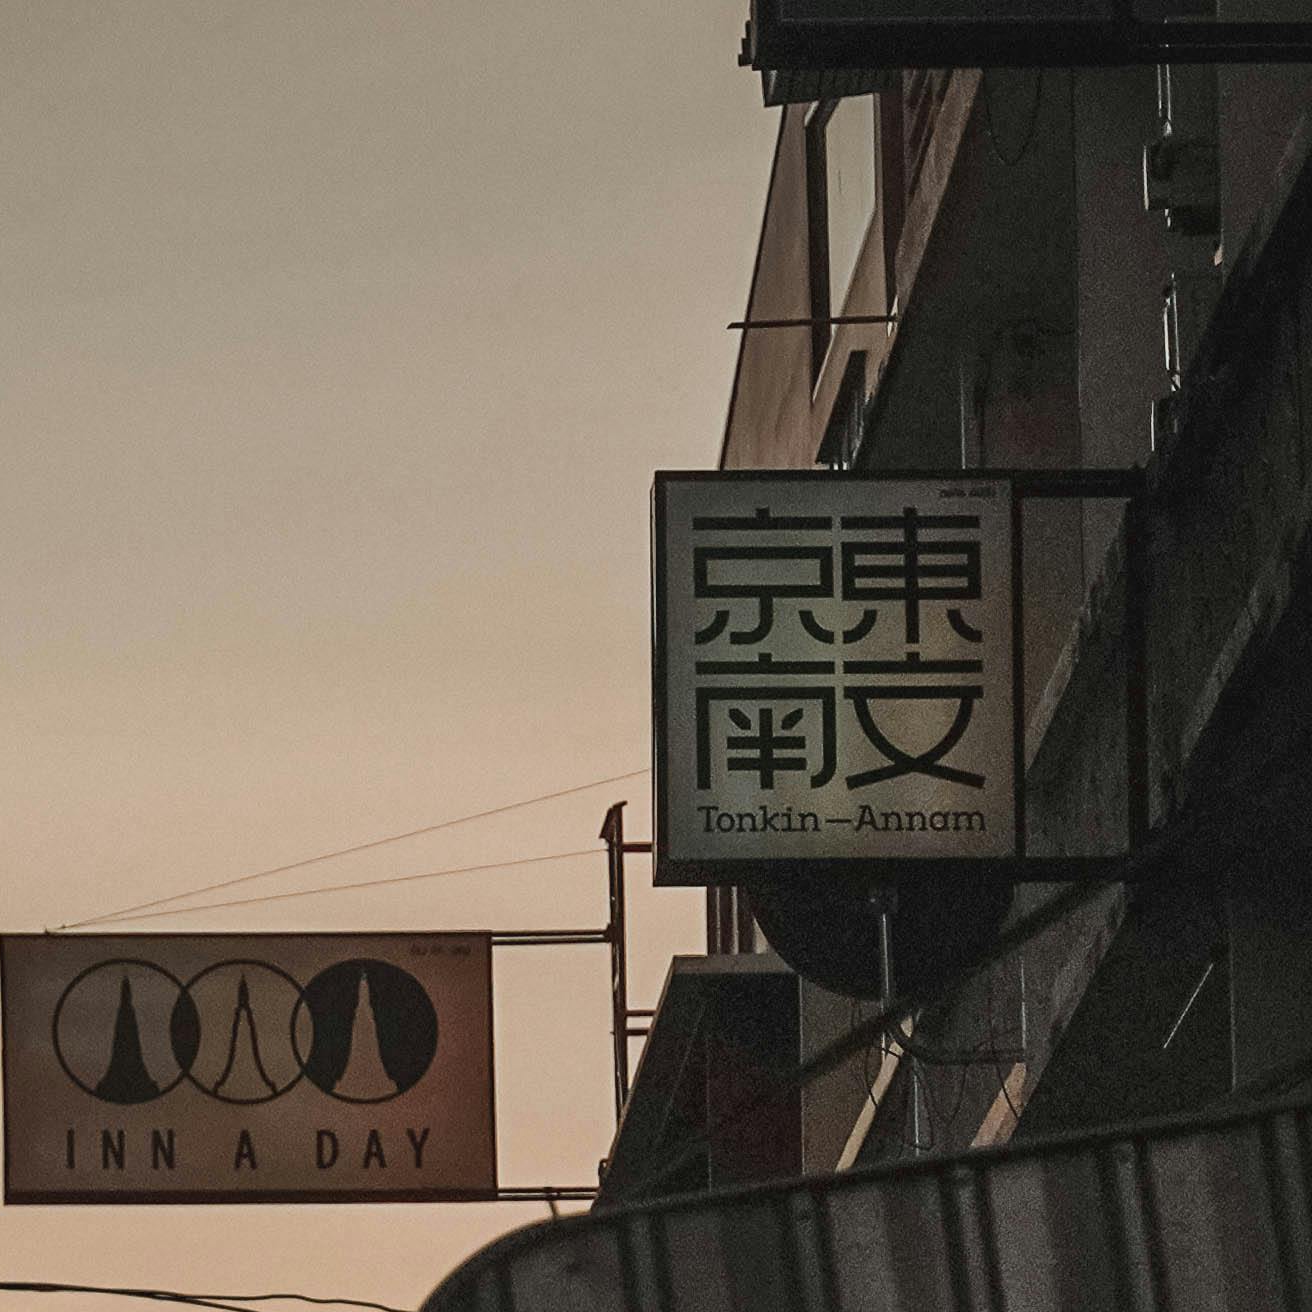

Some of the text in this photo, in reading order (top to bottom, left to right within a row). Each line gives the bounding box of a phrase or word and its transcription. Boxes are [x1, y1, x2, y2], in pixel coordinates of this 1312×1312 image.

[65, 1128, 431, 1170] INN A DAY
